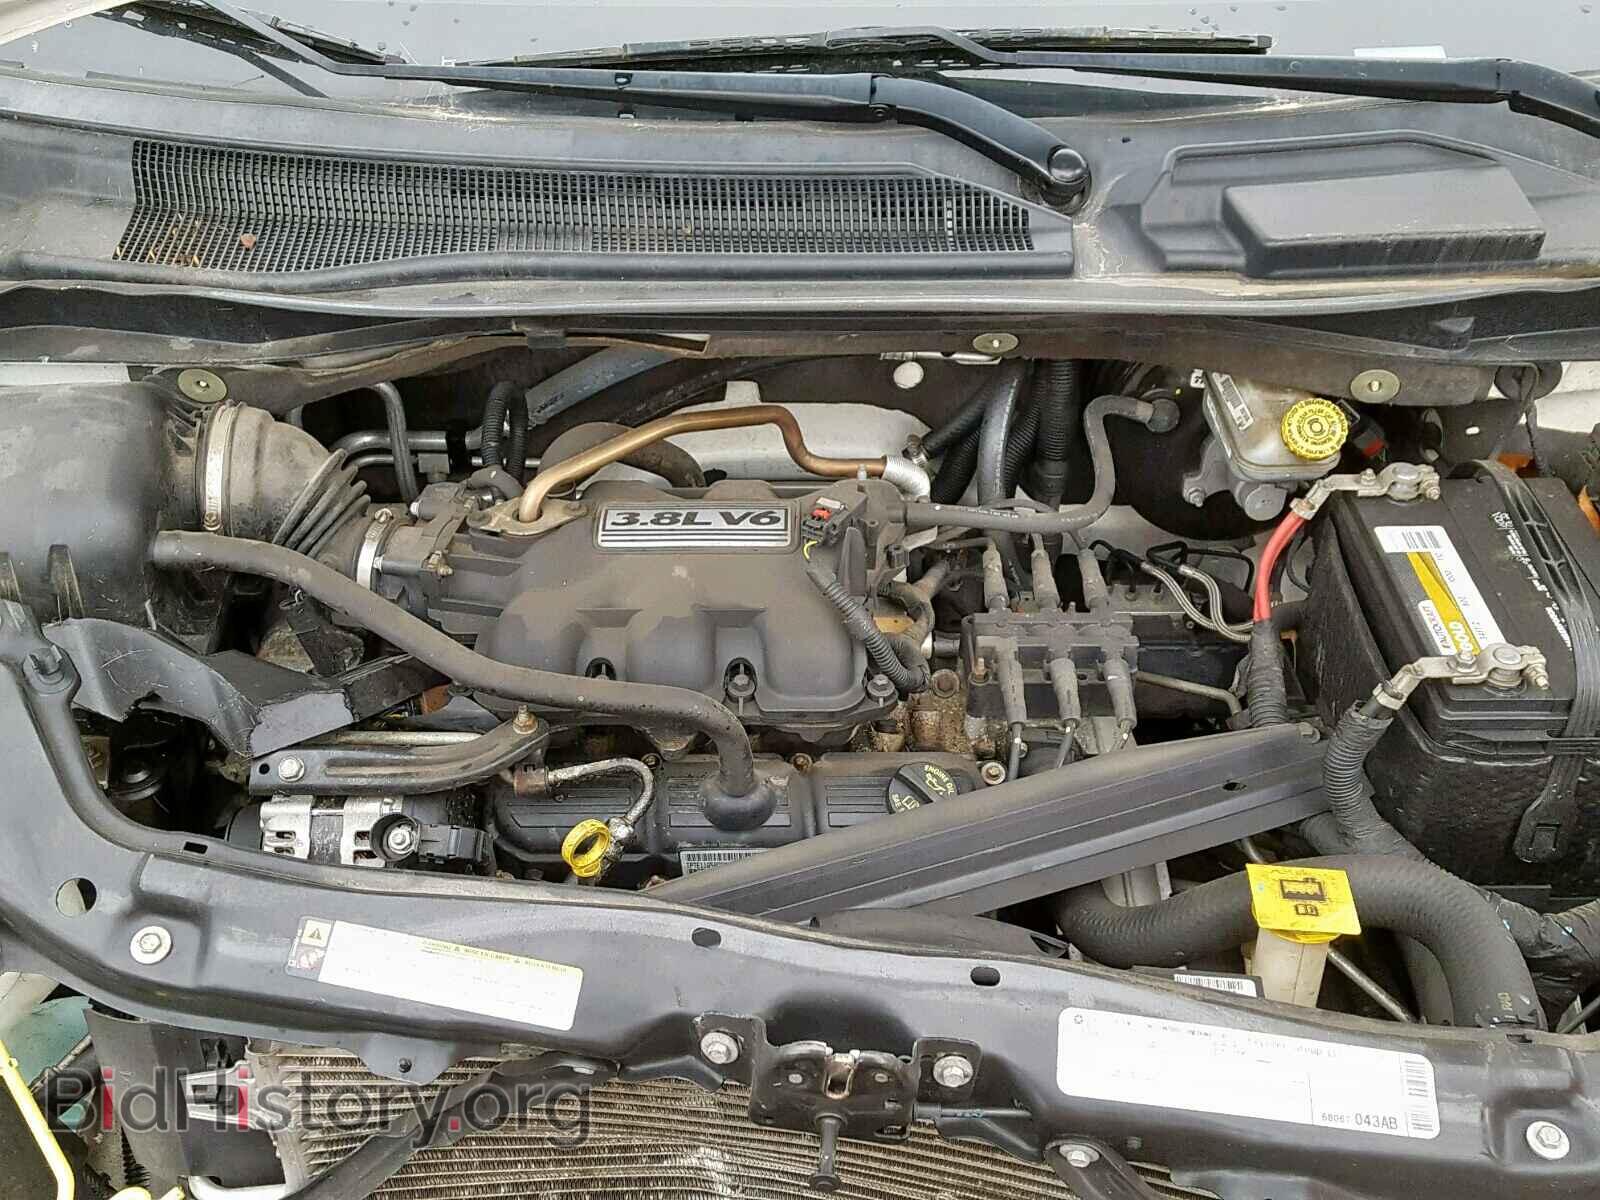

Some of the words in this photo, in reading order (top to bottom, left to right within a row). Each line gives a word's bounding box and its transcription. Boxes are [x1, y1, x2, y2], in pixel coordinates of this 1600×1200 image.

[610, 511, 712, 526] 3.8L
[719, 510, 781, 526] V6
[1354, 1112, 1398, 1130] 043AB
